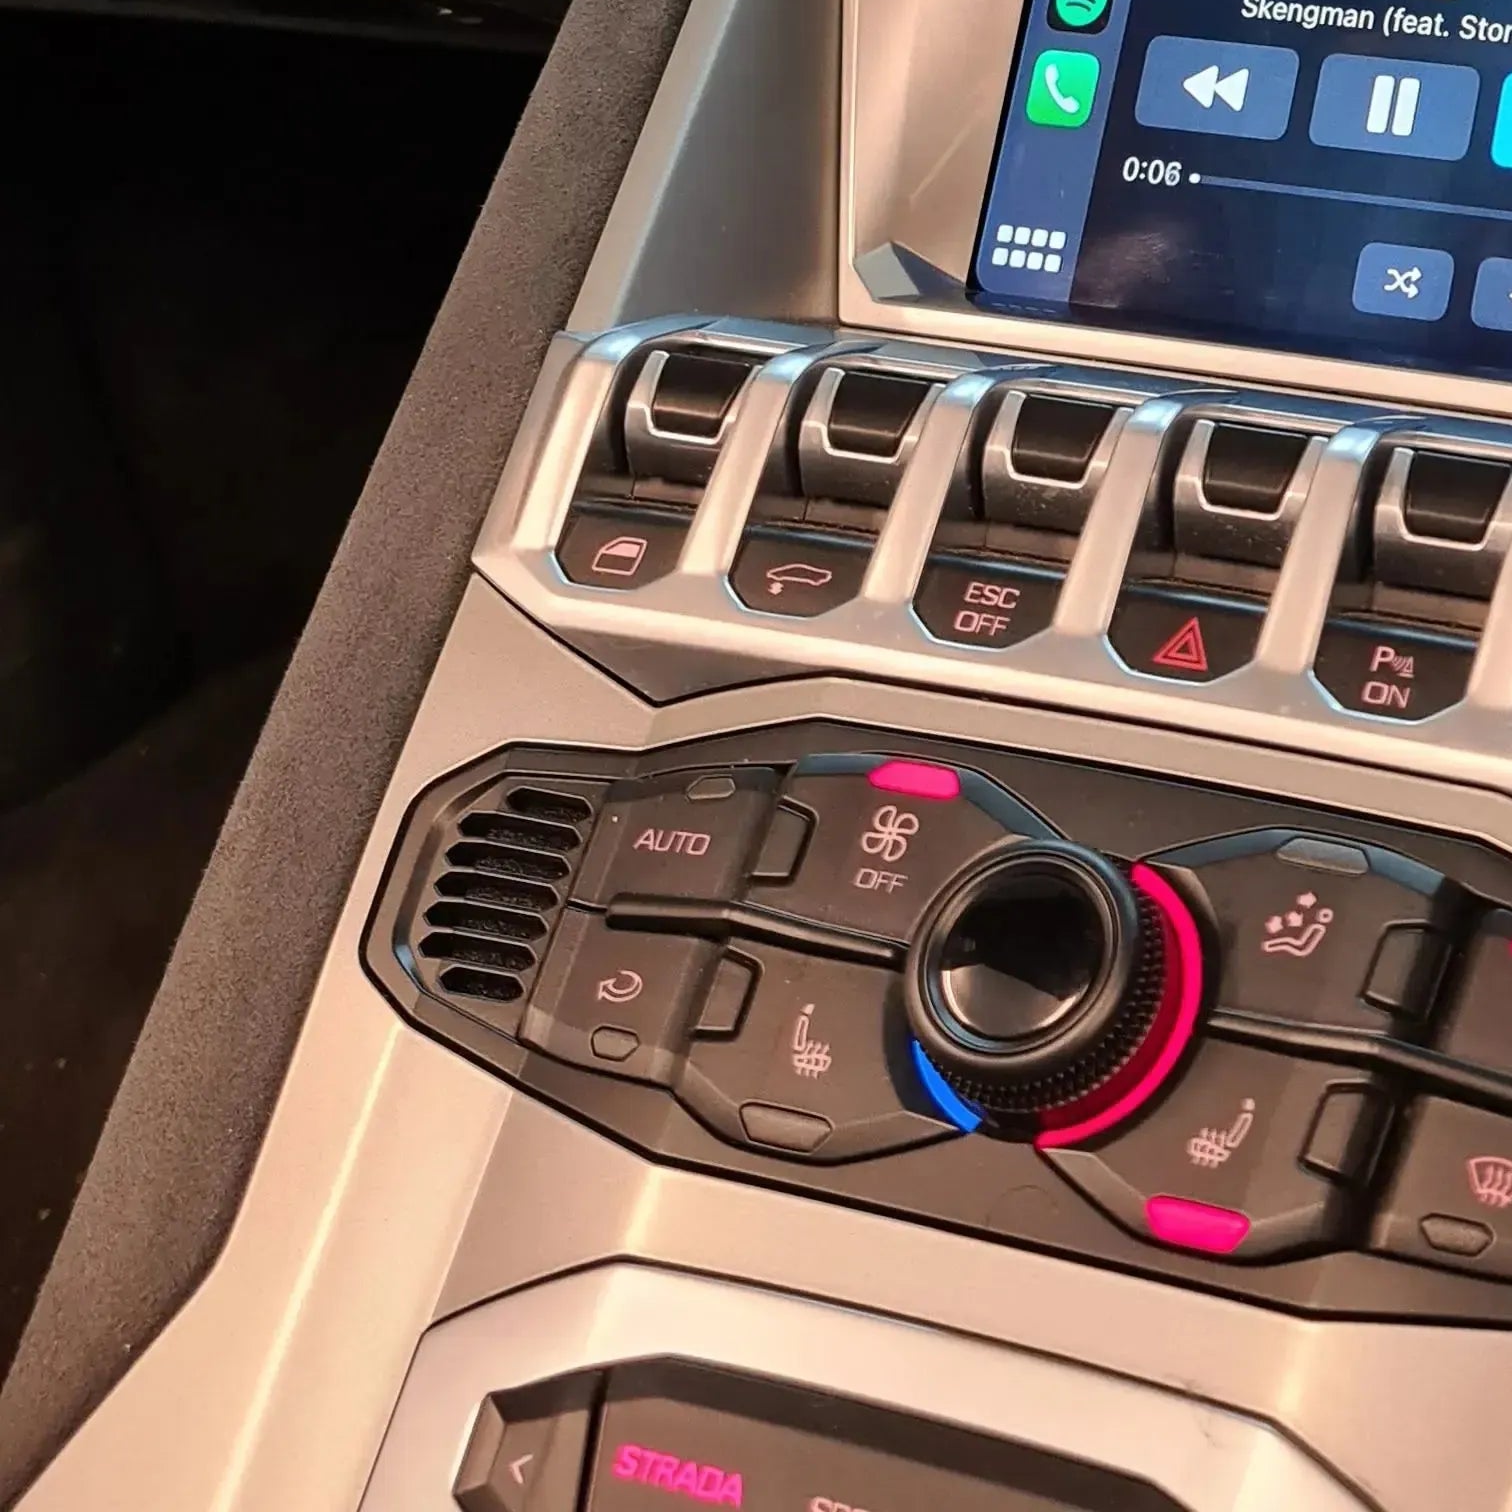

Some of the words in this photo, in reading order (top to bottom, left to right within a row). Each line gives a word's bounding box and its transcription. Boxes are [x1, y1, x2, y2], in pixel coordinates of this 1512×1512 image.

[1382, 6, 1450, 38] (feat.
[1122, 156, 1183, 187] 0:06
[963, 581, 1021, 610] ESC
[953, 609, 1012, 637] OFF
[1361, 680, 1412, 710] ON
[633, 828, 712, 857] AUTO
[854, 868, 909, 894] OFF
[612, 1443, 743, 1509] STRADA
